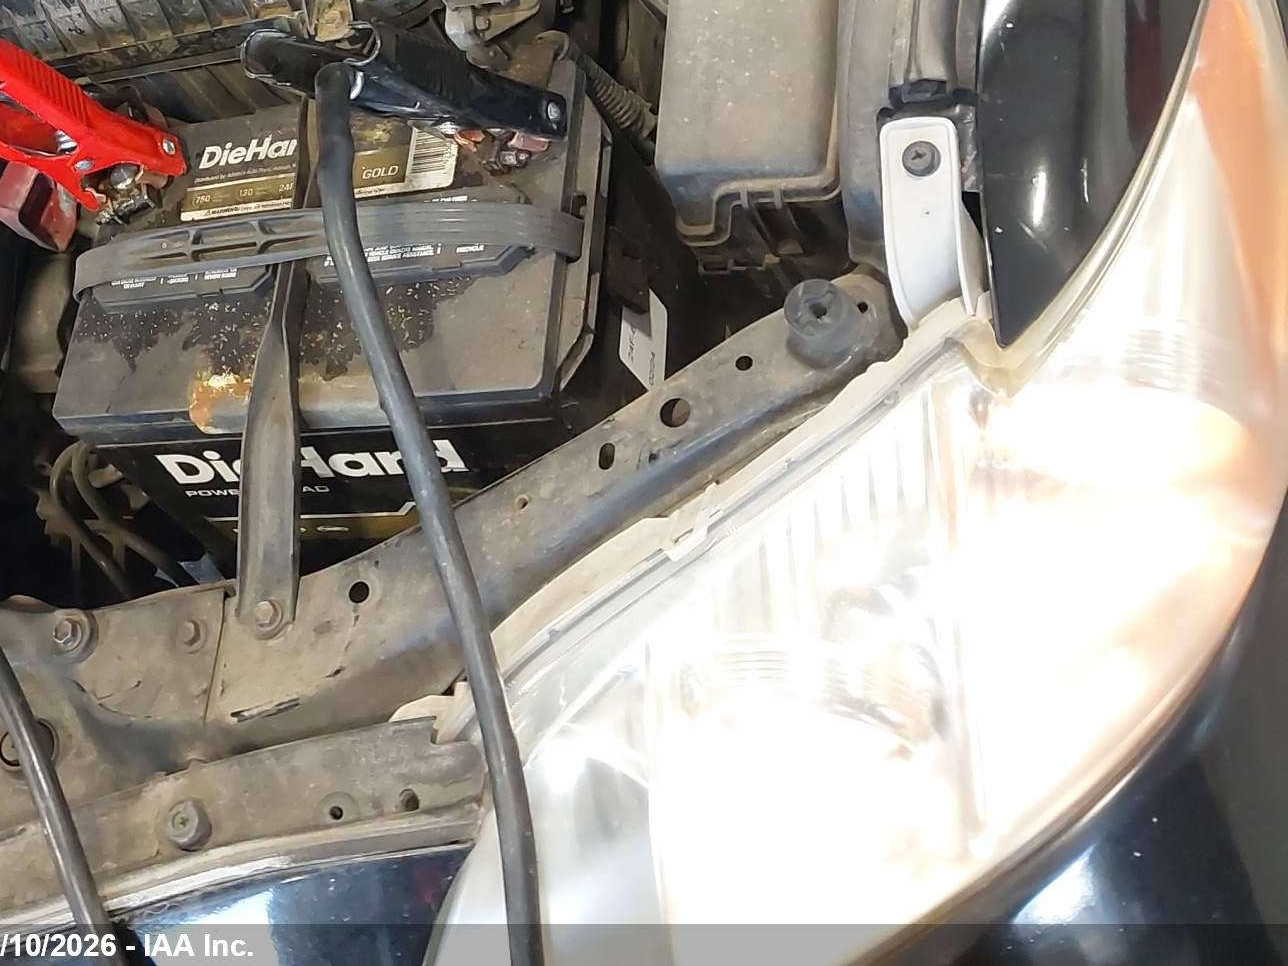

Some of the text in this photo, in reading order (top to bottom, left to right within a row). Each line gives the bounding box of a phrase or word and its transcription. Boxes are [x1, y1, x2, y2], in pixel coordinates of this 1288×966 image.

[198, 134, 298, 170] DieHar
[362, 165, 399, 180] GOLD
[239, 188, 253, 197] 130
[195, 195, 211, 204] 750
[154, 439, 470, 485] DiHard
[184, 487, 240, 498] POWE
